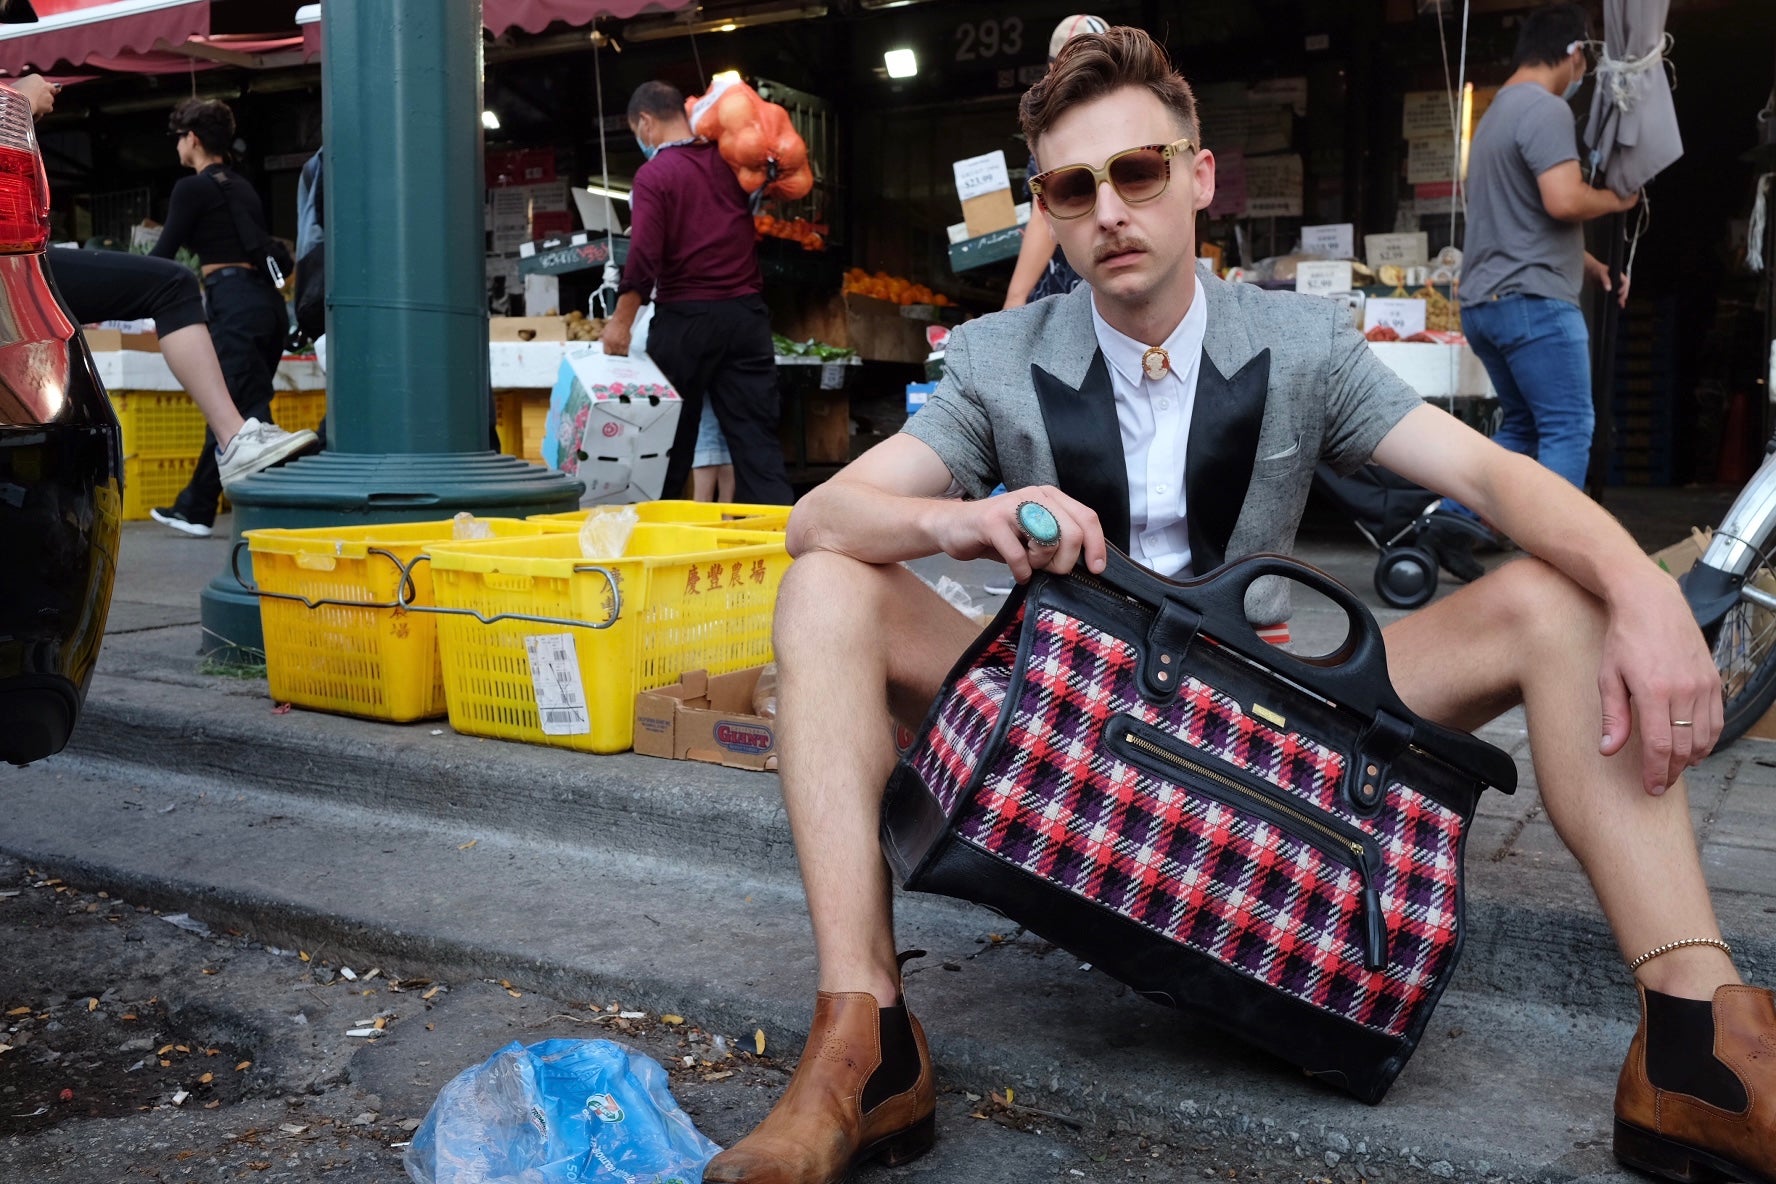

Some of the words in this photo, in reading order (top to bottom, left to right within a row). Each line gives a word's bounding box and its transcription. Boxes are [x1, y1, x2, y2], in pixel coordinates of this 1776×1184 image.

[955, 16, 1024, 61] 293
[683, 558, 767, 596] 慶豐農場
[718, 725, 769, 748] GIANT
